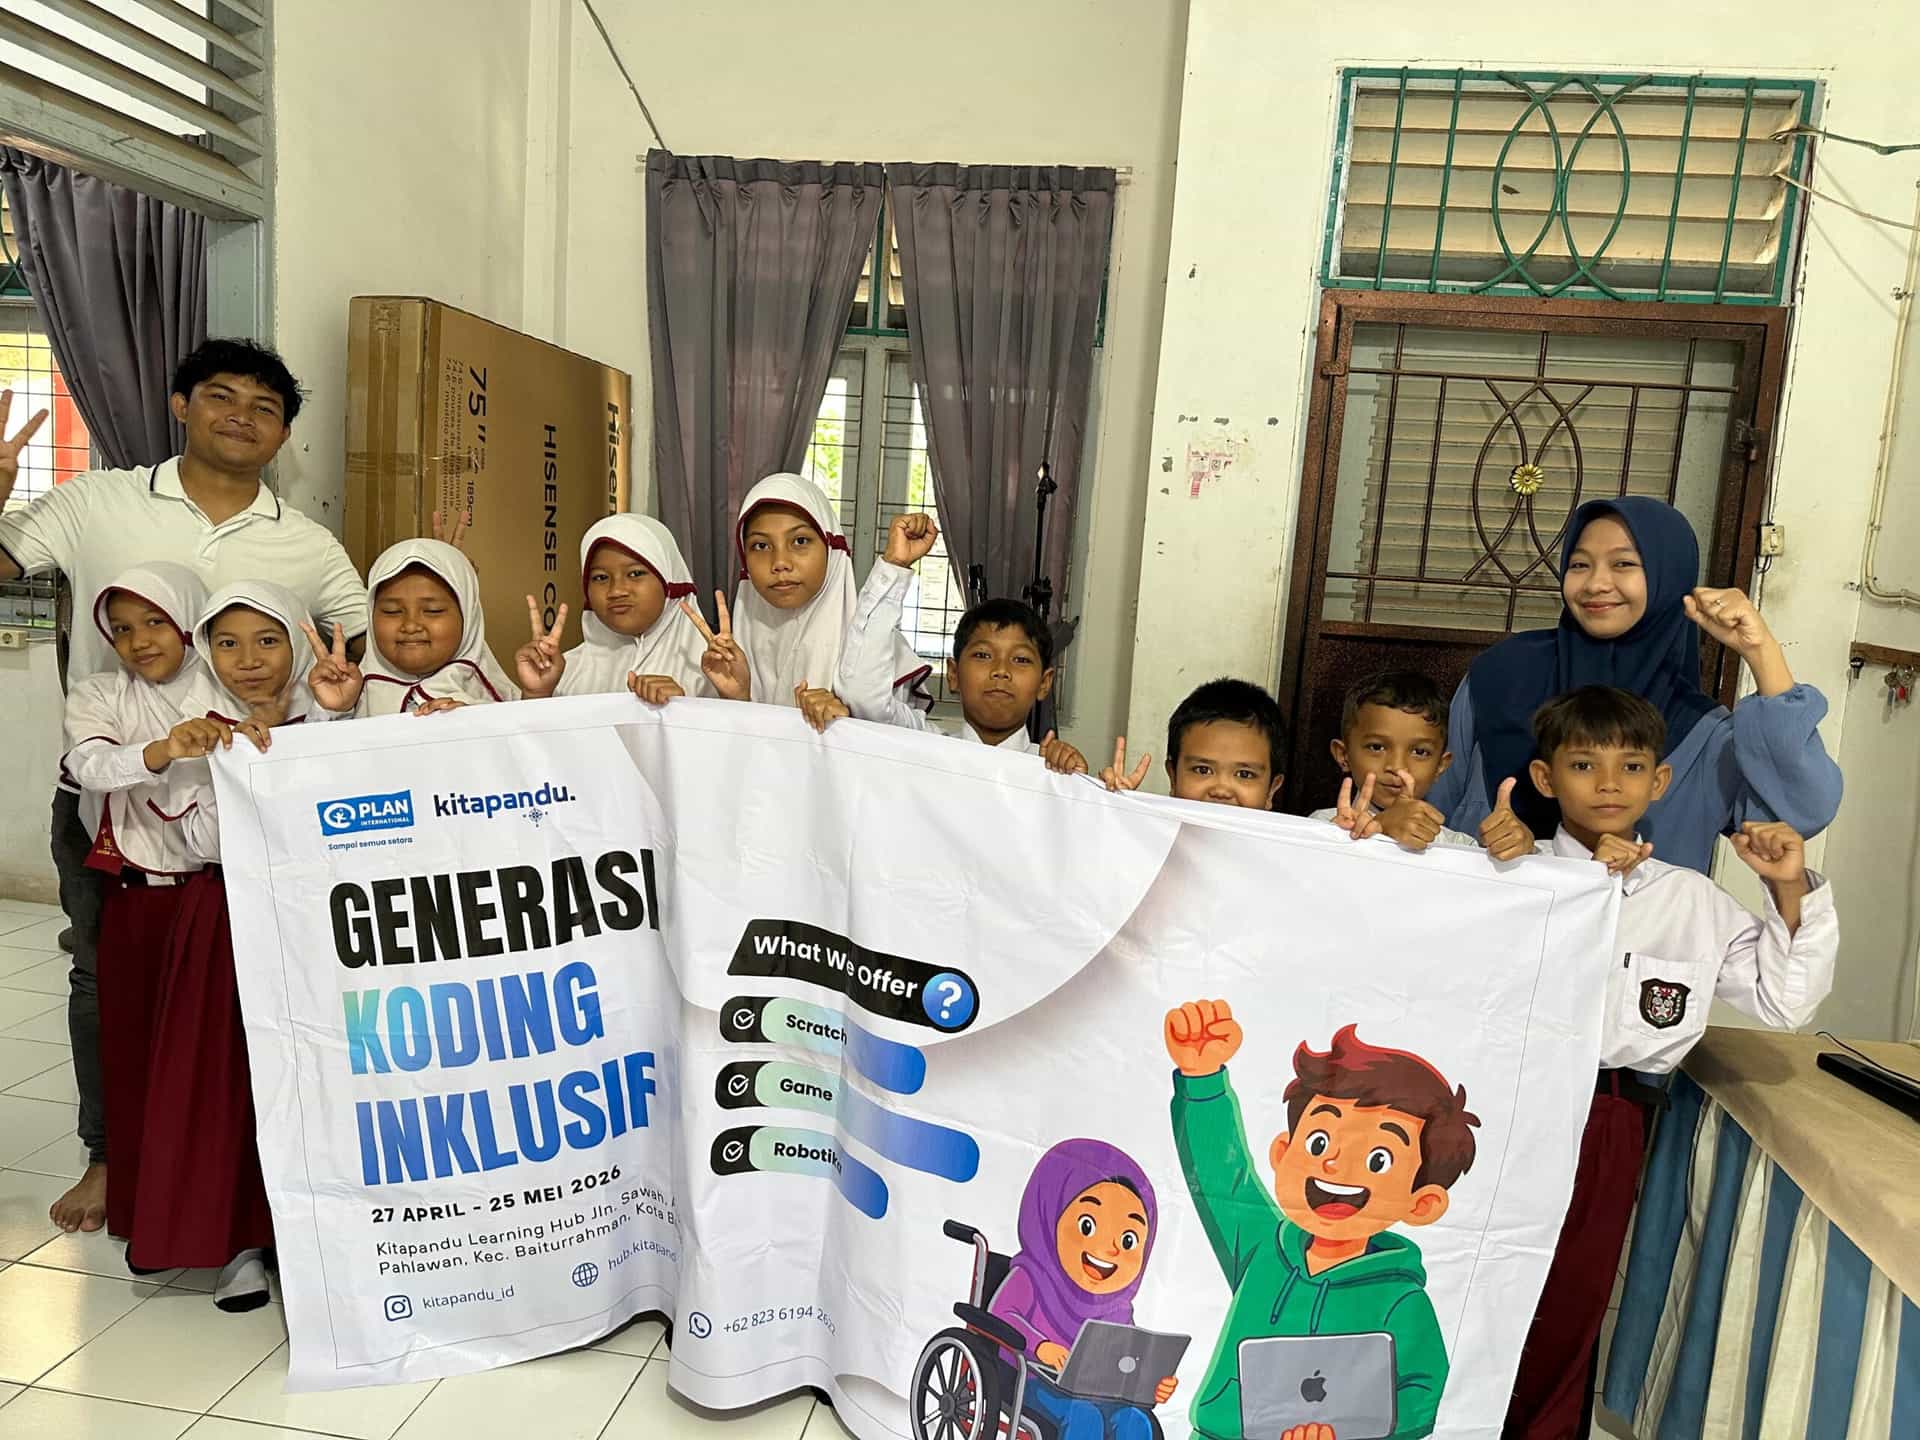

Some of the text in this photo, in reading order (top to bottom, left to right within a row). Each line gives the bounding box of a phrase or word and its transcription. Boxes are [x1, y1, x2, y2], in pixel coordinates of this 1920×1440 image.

[607, 402, 620, 516] Hisen
[466, 480, 475, 527] 189cm
[543, 424, 557, 572] HISENSE
[358, 799, 409, 818] PLAN
[360, 816, 409, 826] INTERNATIONAL
[432, 782, 576, 818] kitapandu.
[329, 848, 660, 969] GENERASI
[752, 935, 821, 963] What
[826, 947, 855, 977] We
[858, 964, 918, 999] Offer
[342, 961, 604, 1076] KODING
[785, 1013, 848, 1046] Scratch
[779, 1078, 833, 1101] Game
[355, 1051, 657, 1186] INKLUSIF
[773, 1141, 843, 1176] Robotika
[371, 1207, 394, 1223] 27
[403, 1203, 466, 1222] APRIL
[490, 1193, 516, 1213] 25
[523, 1185, 563, 1205] MEI
[571, 1164, 621, 1195] 2026
[376, 1237, 462, 1258] Kitapandu
[468, 1225, 544, 1246] Learning
[550, 1212, 585, 1233] Hub
[591, 1205, 617, 1220] Jln.
[473, 1250, 509, 1263] Kec.
[636, 1202, 664, 1220] Kota
[422, 1285, 515, 1309] kitapandu_id
[723, 1317, 748, 1333] +62
[751, 1309, 775, 1327] 823
[778, 1305, 813, 1320] 6194
